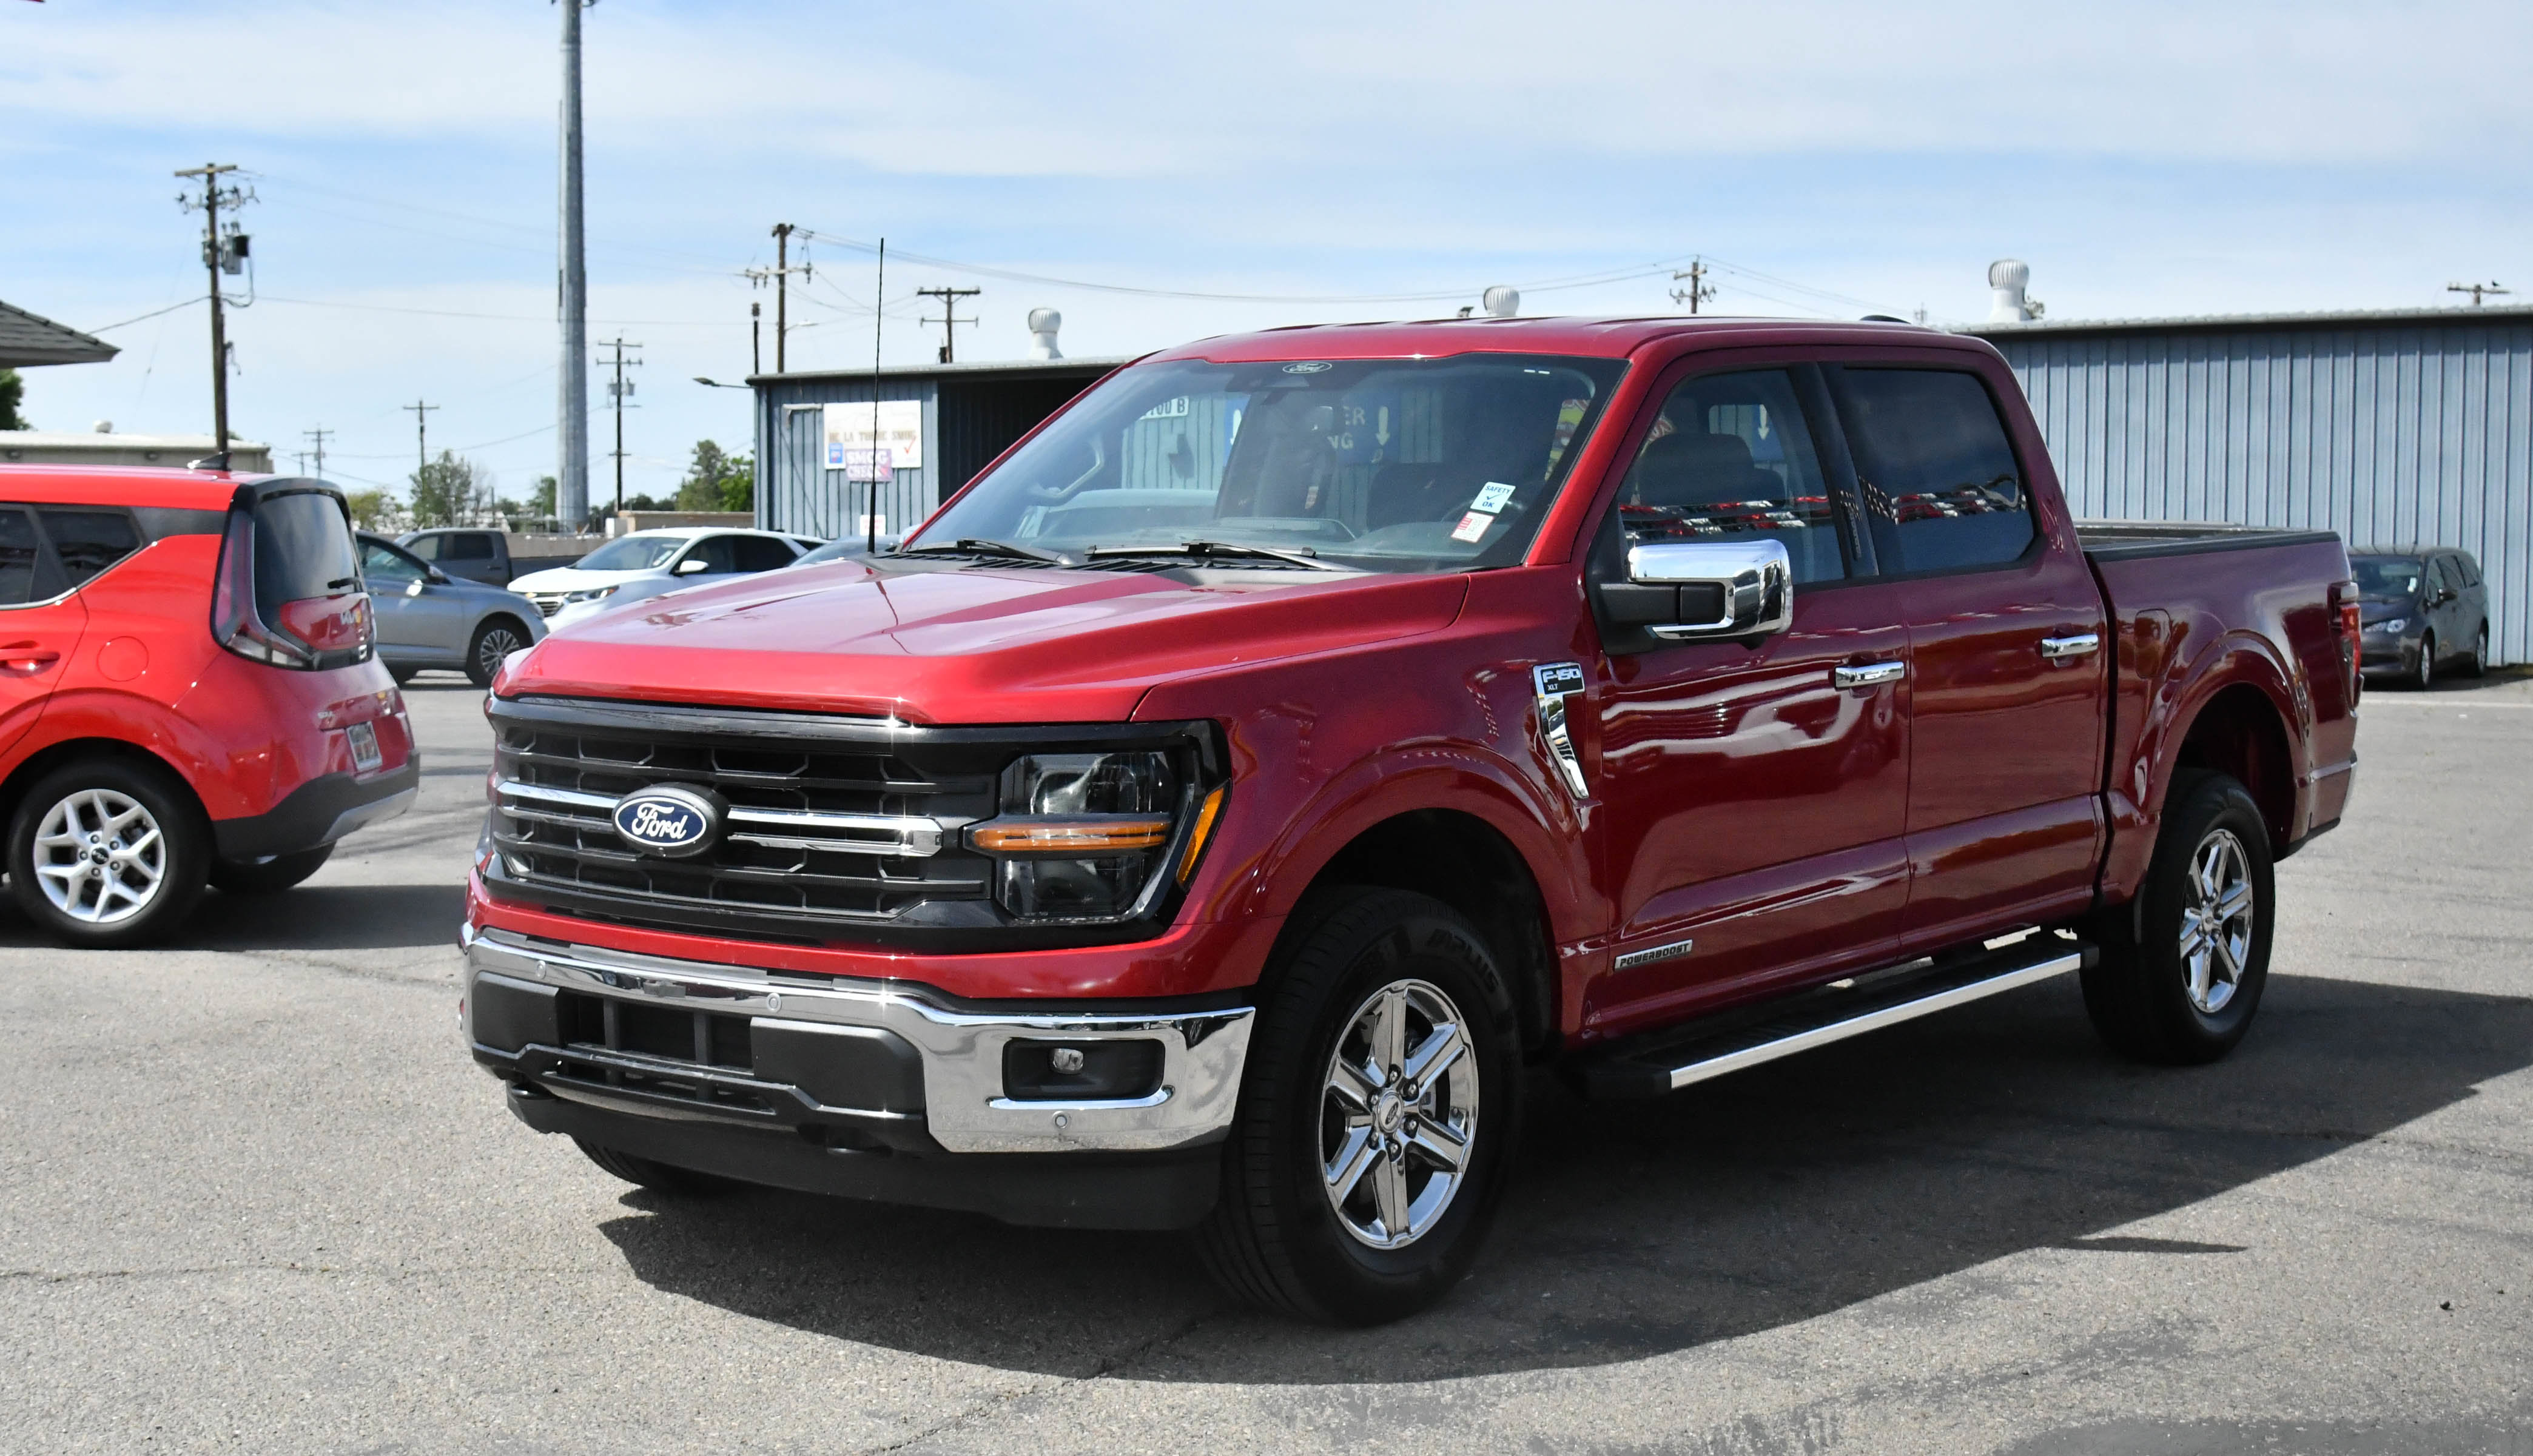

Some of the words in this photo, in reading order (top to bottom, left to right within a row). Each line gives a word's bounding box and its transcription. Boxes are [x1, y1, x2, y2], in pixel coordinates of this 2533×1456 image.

[1288, 362, 1325, 372] Ford
[846, 451, 889, 465] SMOG
[1485, 485, 1512, 494] SAFETY
[1547, 683, 1558, 691] XLT
[631, 802, 689, 840] Ford
[1620, 943, 1689, 967] POWERBOOST
